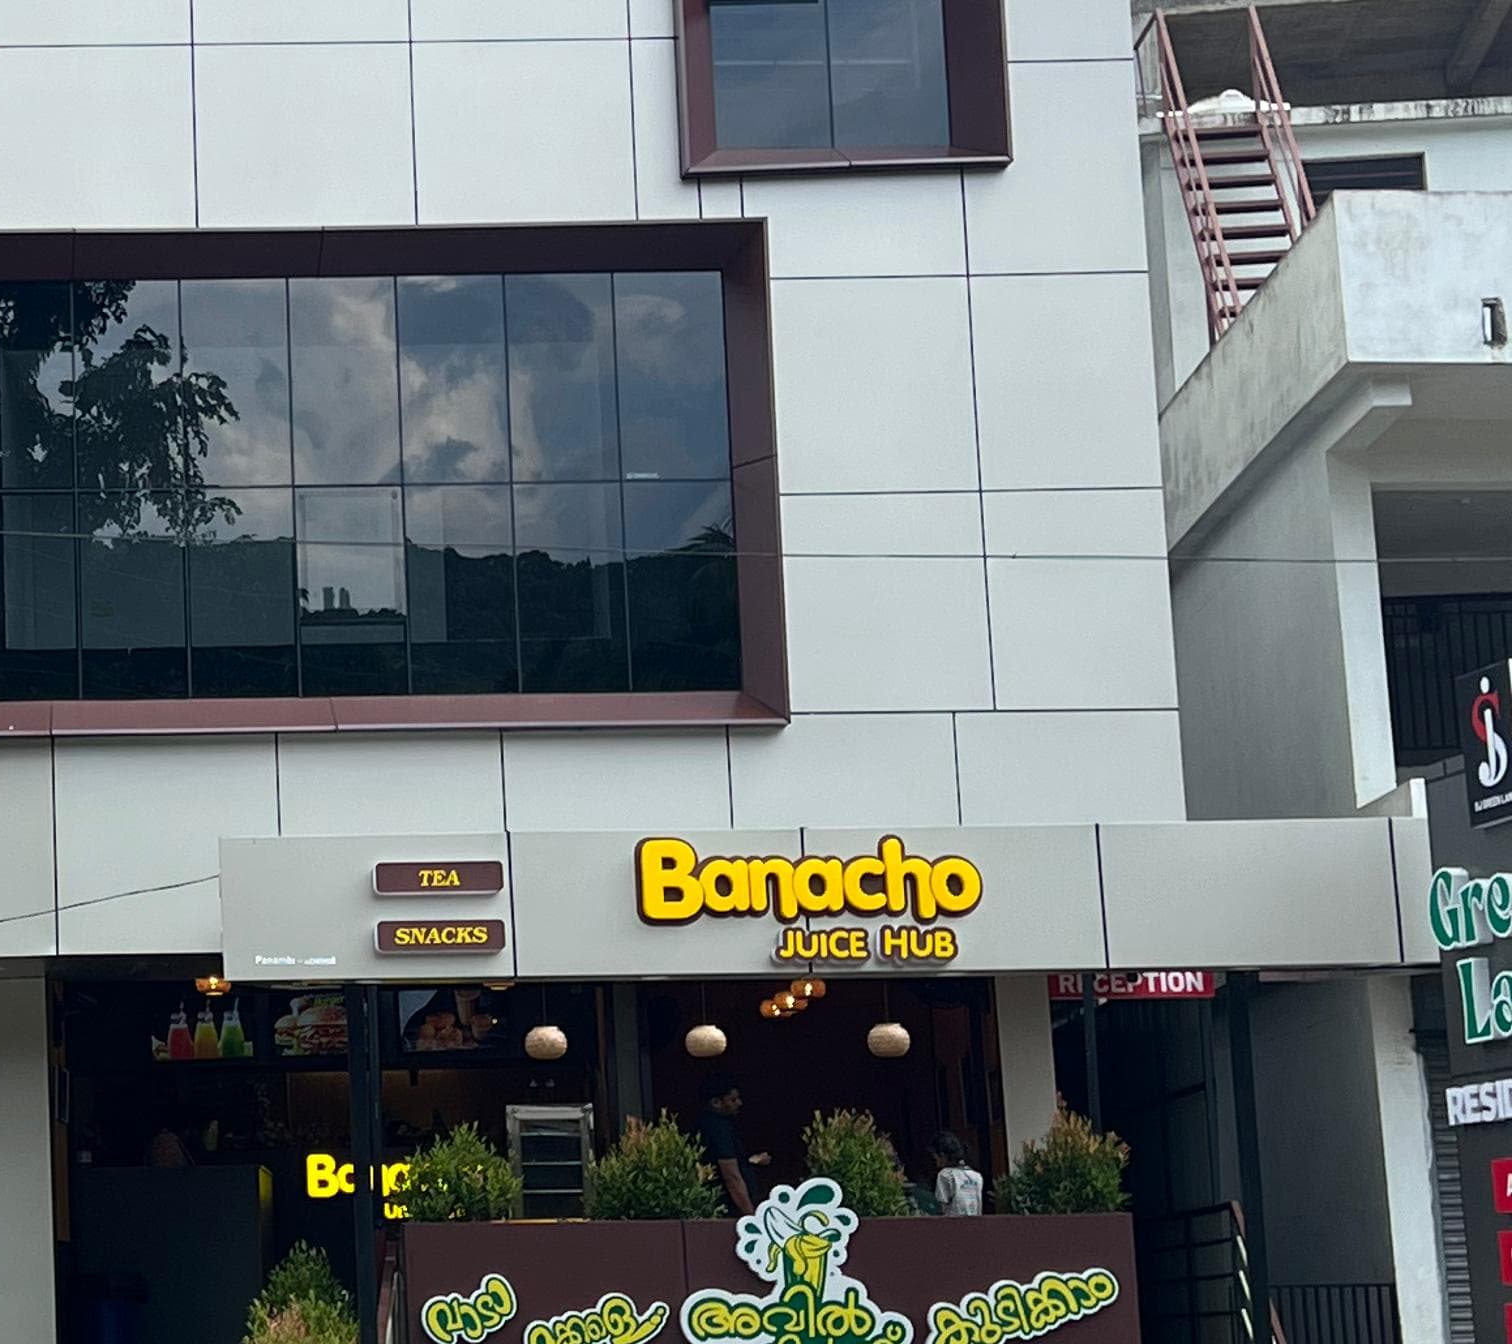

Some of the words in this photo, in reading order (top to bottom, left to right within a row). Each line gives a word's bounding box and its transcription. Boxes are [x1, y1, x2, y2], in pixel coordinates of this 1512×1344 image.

[418, 869, 460, 887] TEA
[637, 835, 983, 925] Banacho
[394, 926, 488, 945] SNACKS
[779, 929, 869, 959] JUICE
[884, 928, 957, 959] HUB
[690, 1283, 874, 1338] അവിൽ
